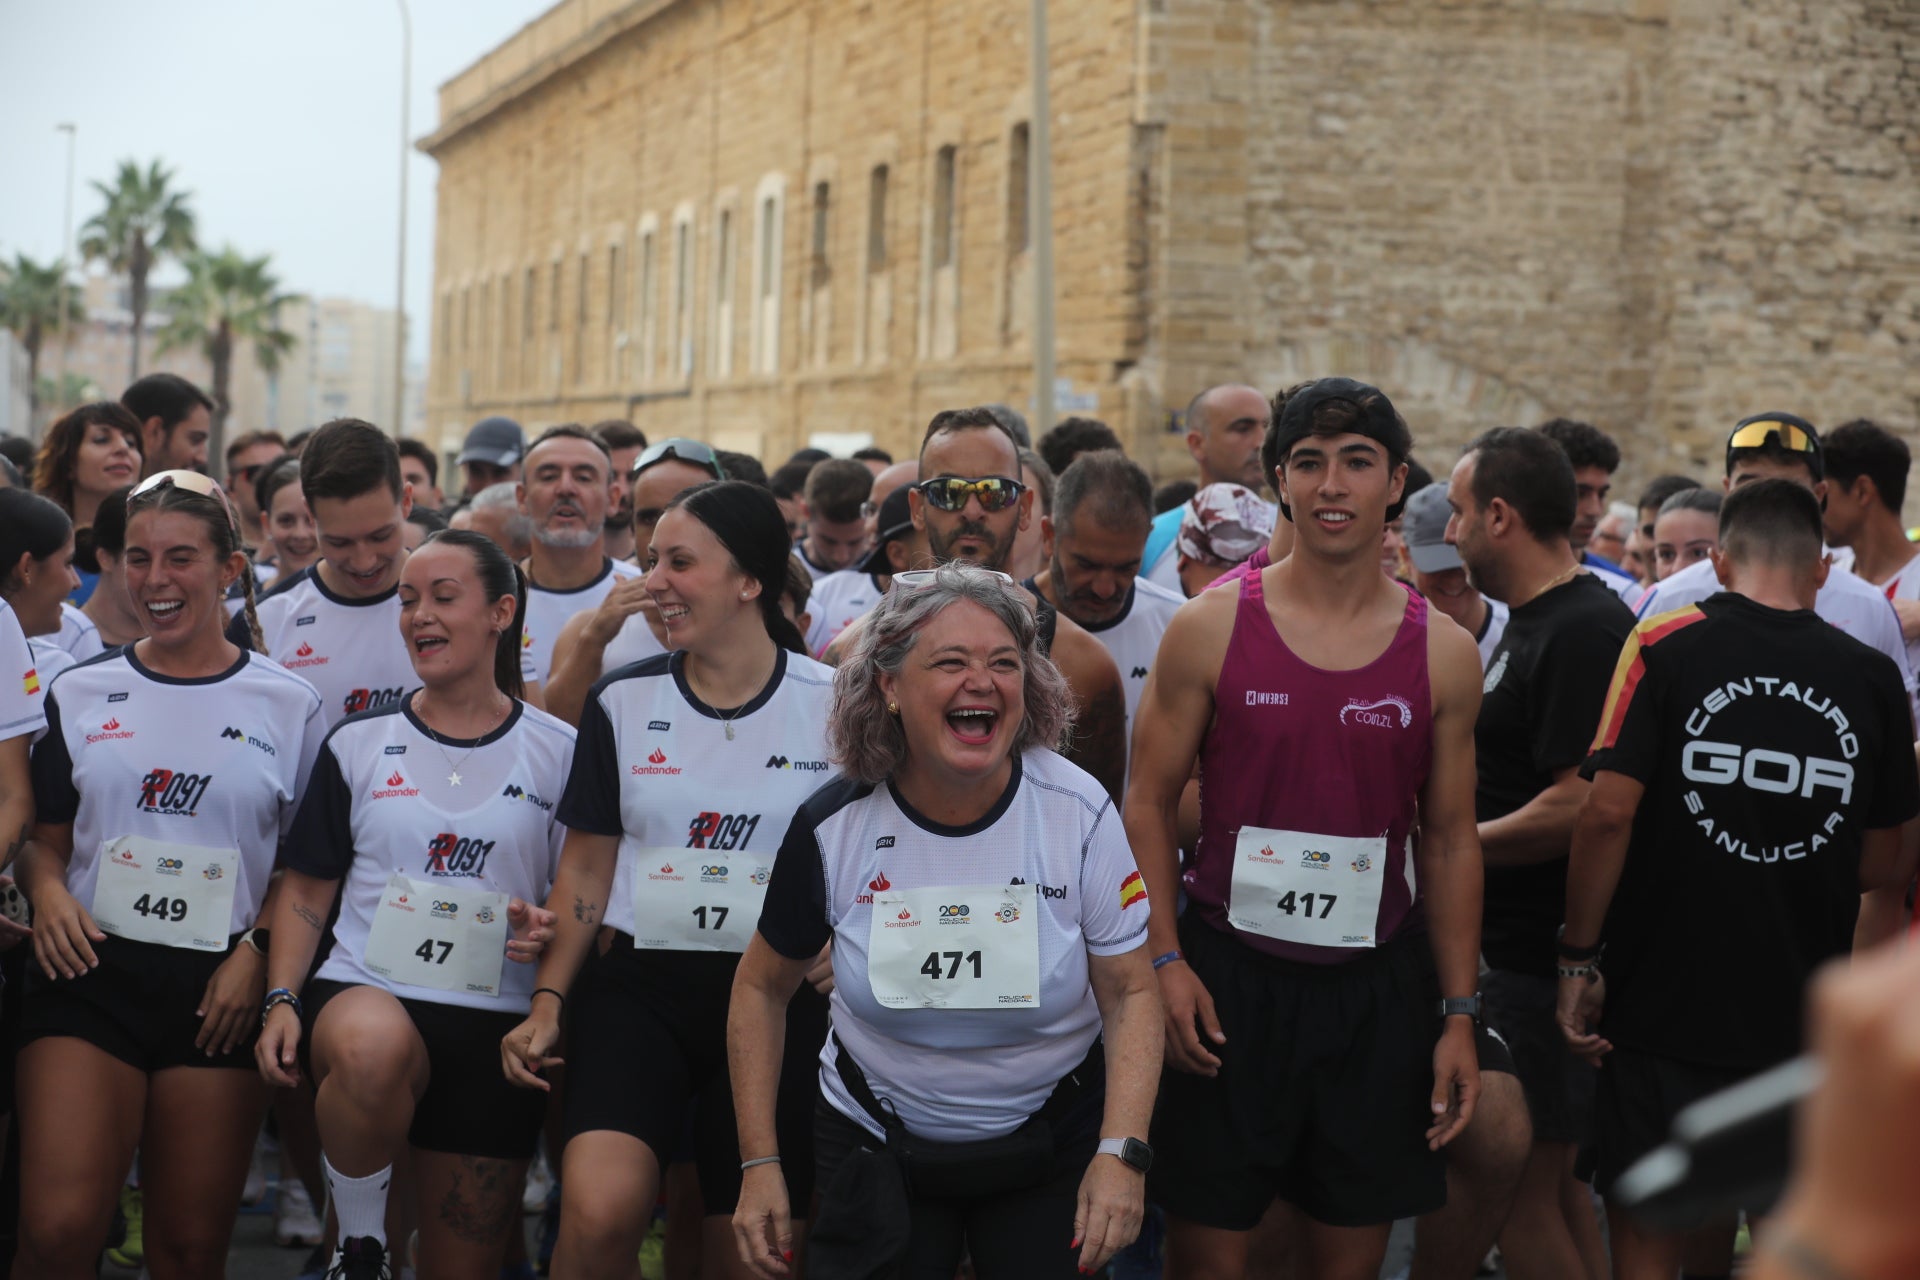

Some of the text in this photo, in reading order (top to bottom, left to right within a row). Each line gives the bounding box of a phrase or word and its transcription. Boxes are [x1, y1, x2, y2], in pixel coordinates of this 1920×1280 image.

[1685, 676, 1859, 760] CENTAURO
[86, 731, 135, 744] Santander
[632, 765, 682, 775] Santander
[1681, 740, 1855, 804] GOR
[372, 787, 420, 800] Santander
[1683, 790, 1845, 863] SANLUCAR
[1248, 855, 1285, 865] Santander
[1302, 850, 1330, 862] 200
[648, 873, 684, 881] Santander
[701, 865, 729, 876] 200
[133, 893, 187, 922] 449
[387, 900, 416, 912] Santander
[939, 905, 969, 916] 200
[1277, 890, 1338, 919] 417
[692, 906, 729, 930] 17
[884, 920, 921, 928] Santander
[415, 939, 454, 965] 47
[920, 951, 982, 979] 471
